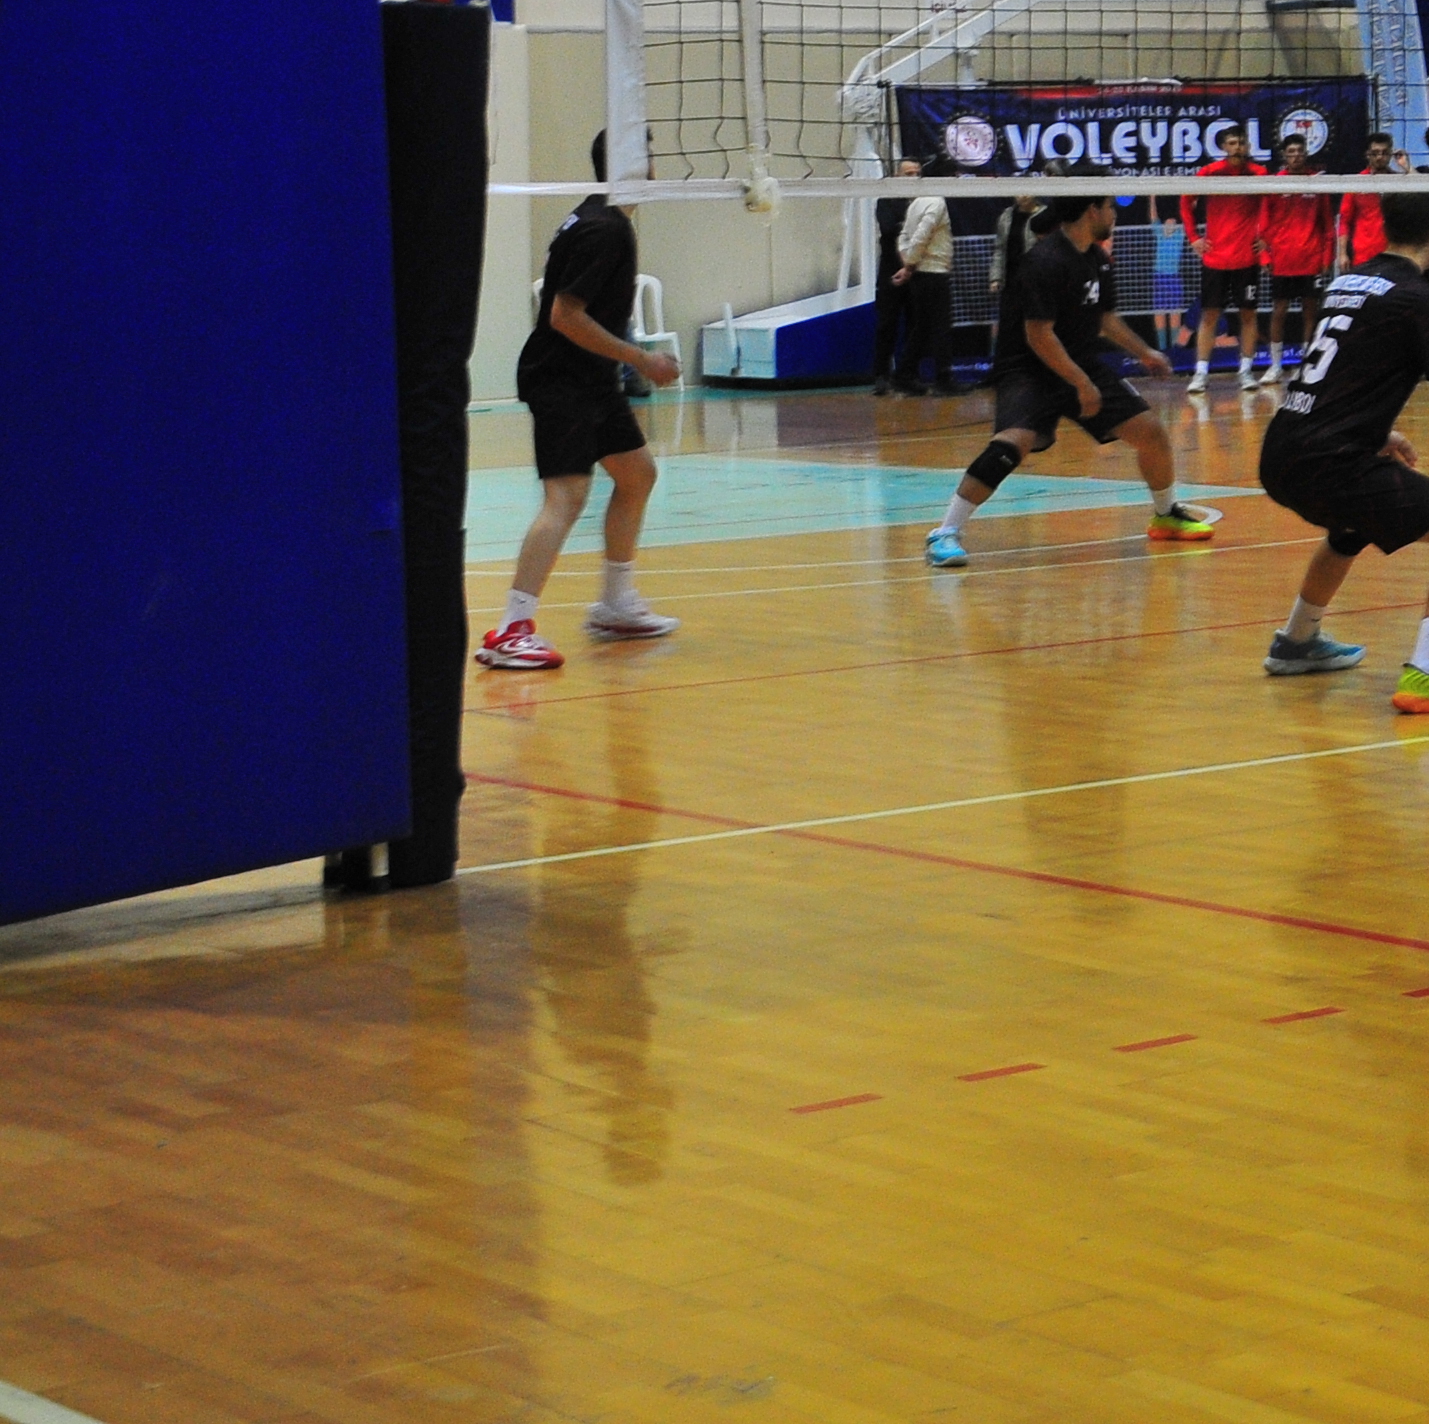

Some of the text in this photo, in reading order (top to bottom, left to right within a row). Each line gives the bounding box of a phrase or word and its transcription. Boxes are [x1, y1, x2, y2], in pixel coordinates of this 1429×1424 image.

[1178, 105, 1221, 117] ARASI
[1007, 118, 1272, 169] VOLEYBOL
[1302, 314, 1354, 384] 5
